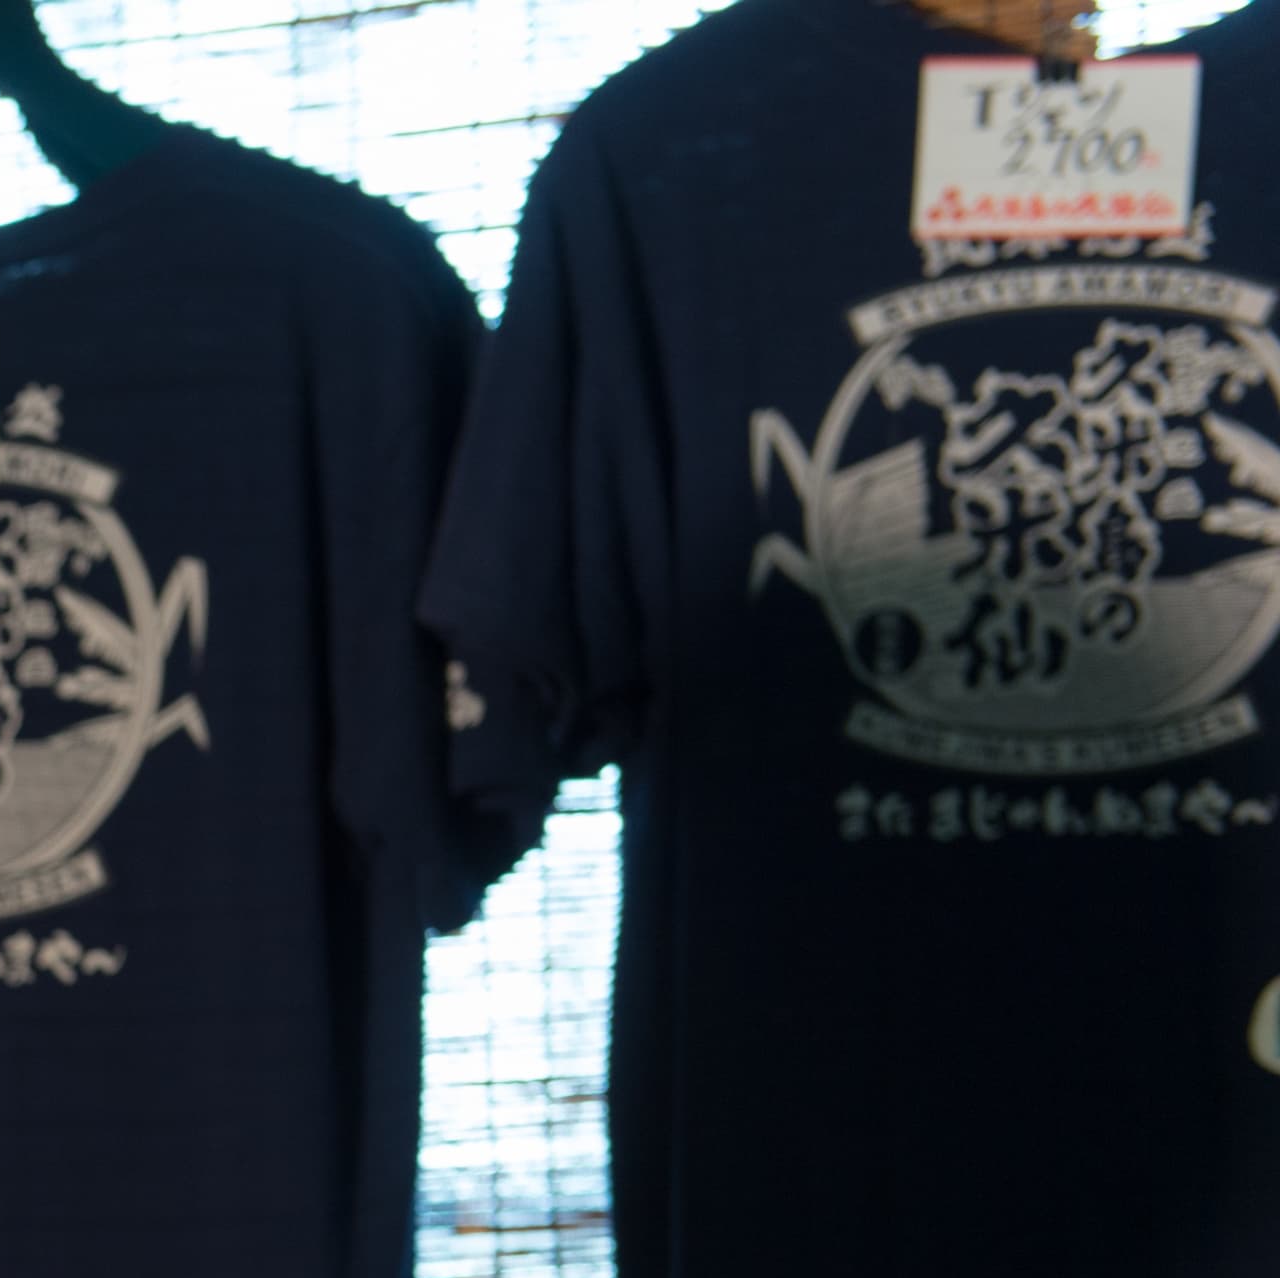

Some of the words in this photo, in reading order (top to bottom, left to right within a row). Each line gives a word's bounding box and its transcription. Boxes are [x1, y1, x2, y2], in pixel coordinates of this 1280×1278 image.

[1000, 127, 1147, 177] 2700
[942, 384, 1070, 690] 久米仙
